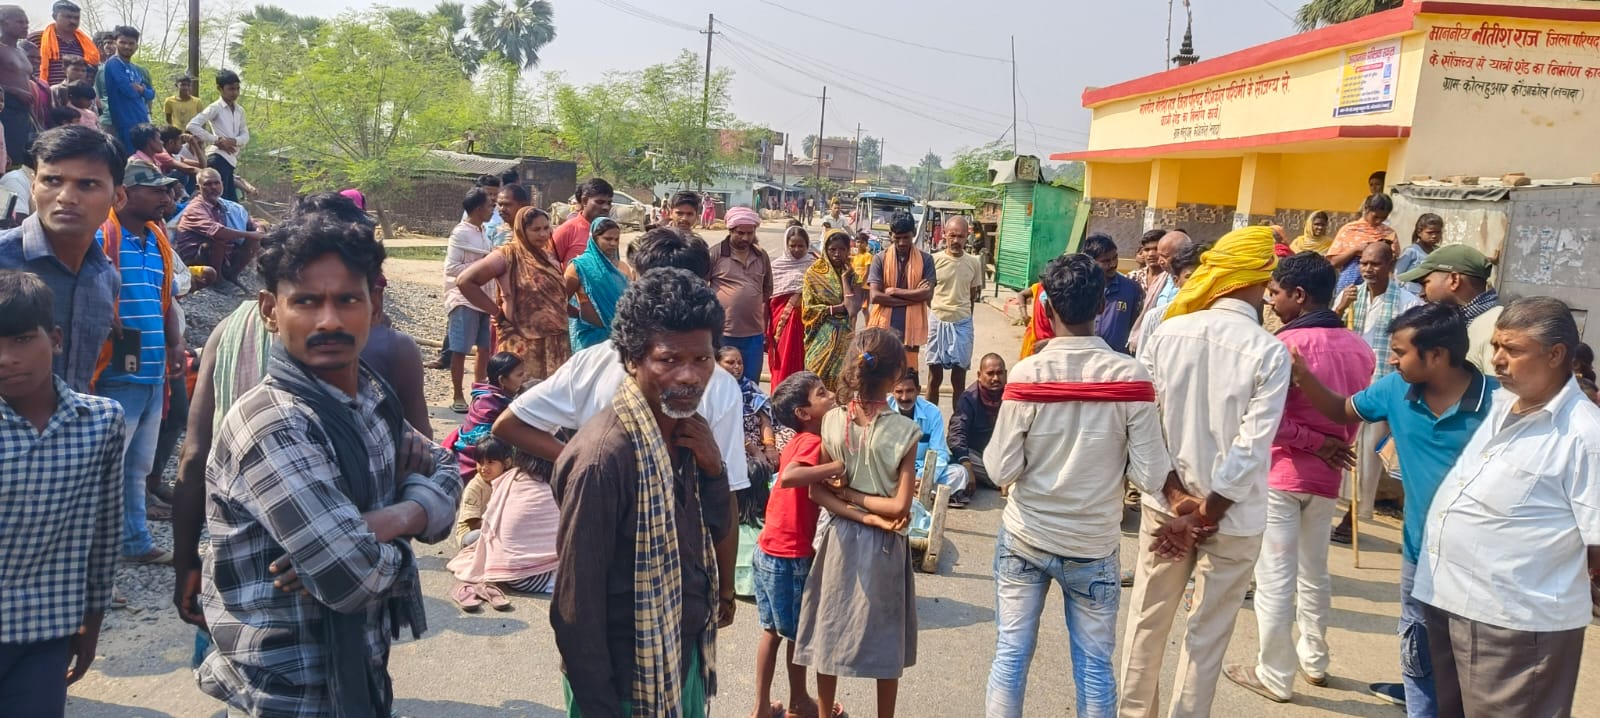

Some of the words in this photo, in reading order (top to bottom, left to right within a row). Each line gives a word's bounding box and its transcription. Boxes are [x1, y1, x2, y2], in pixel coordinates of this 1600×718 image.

[1429, 22, 1472, 41] माननीय
[1472, 21, 1514, 48] नीतीश
[1513, 29, 1542, 48] राज
[1429, 50, 1439, 67] के
[1488, 57, 1514, 73] यात्री
[1533, 63, 1545, 75] का
